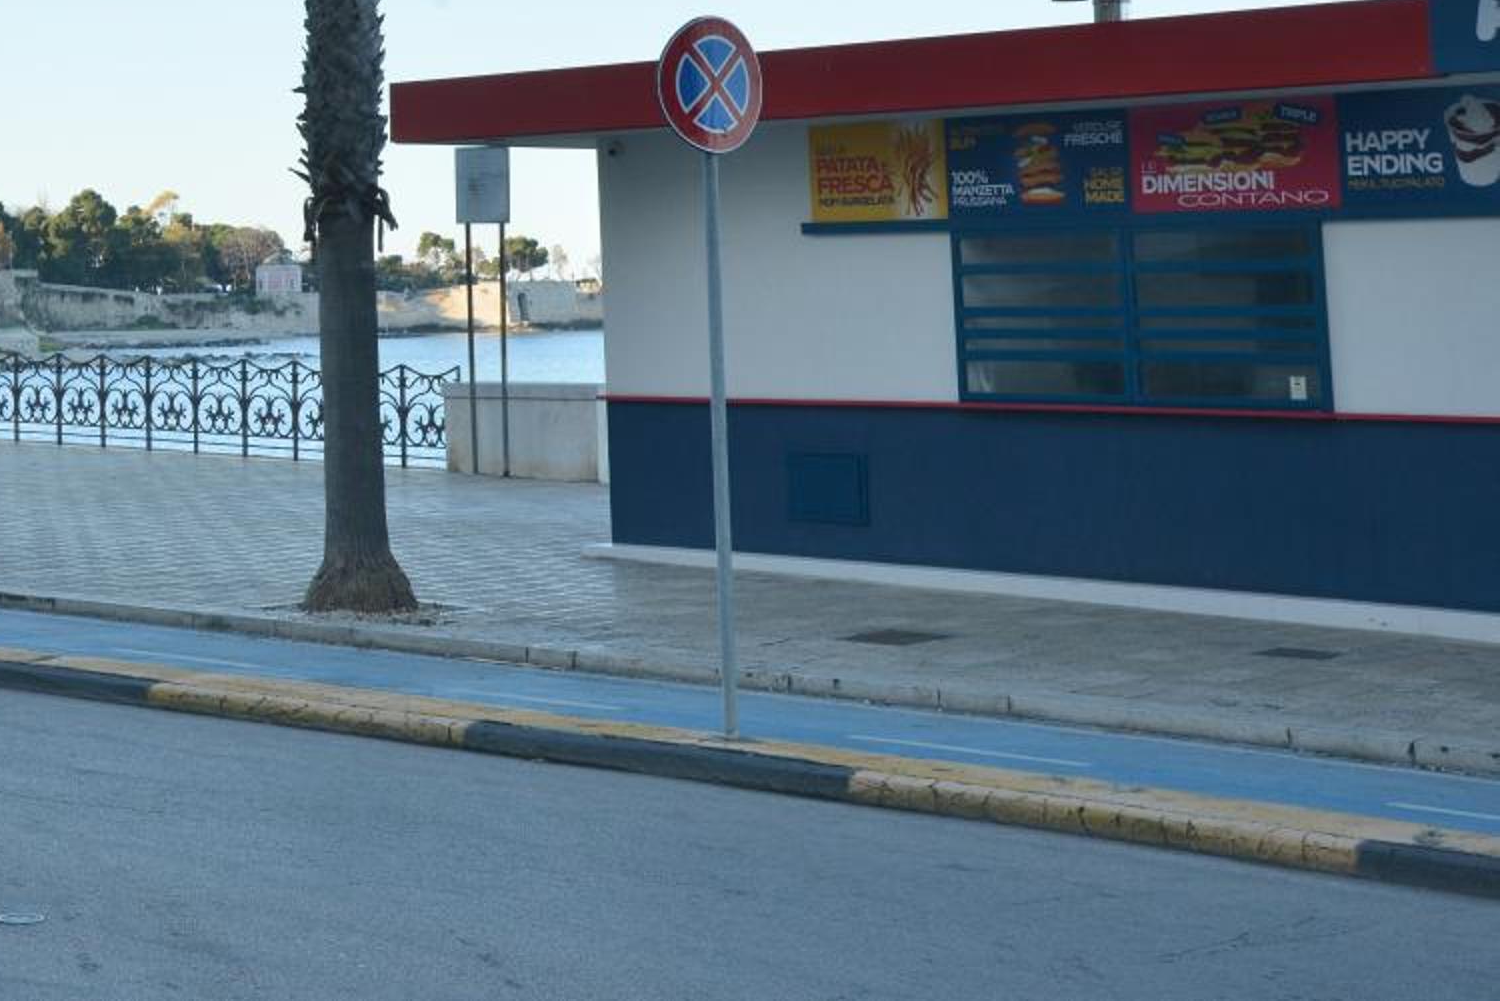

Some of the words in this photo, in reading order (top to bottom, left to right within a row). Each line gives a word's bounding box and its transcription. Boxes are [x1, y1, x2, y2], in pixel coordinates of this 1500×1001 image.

[1346, 128, 1430, 152] HAPPY
[818, 155, 879, 174] PATATA
[1347, 152, 1444, 176] ENDING
[818, 174, 894, 194] FRESCA
[952, 170, 989, 184] 100%
[1142, 170, 1275, 194] DIMENSIONI
[1178, 189, 1329, 207] CONTANO
